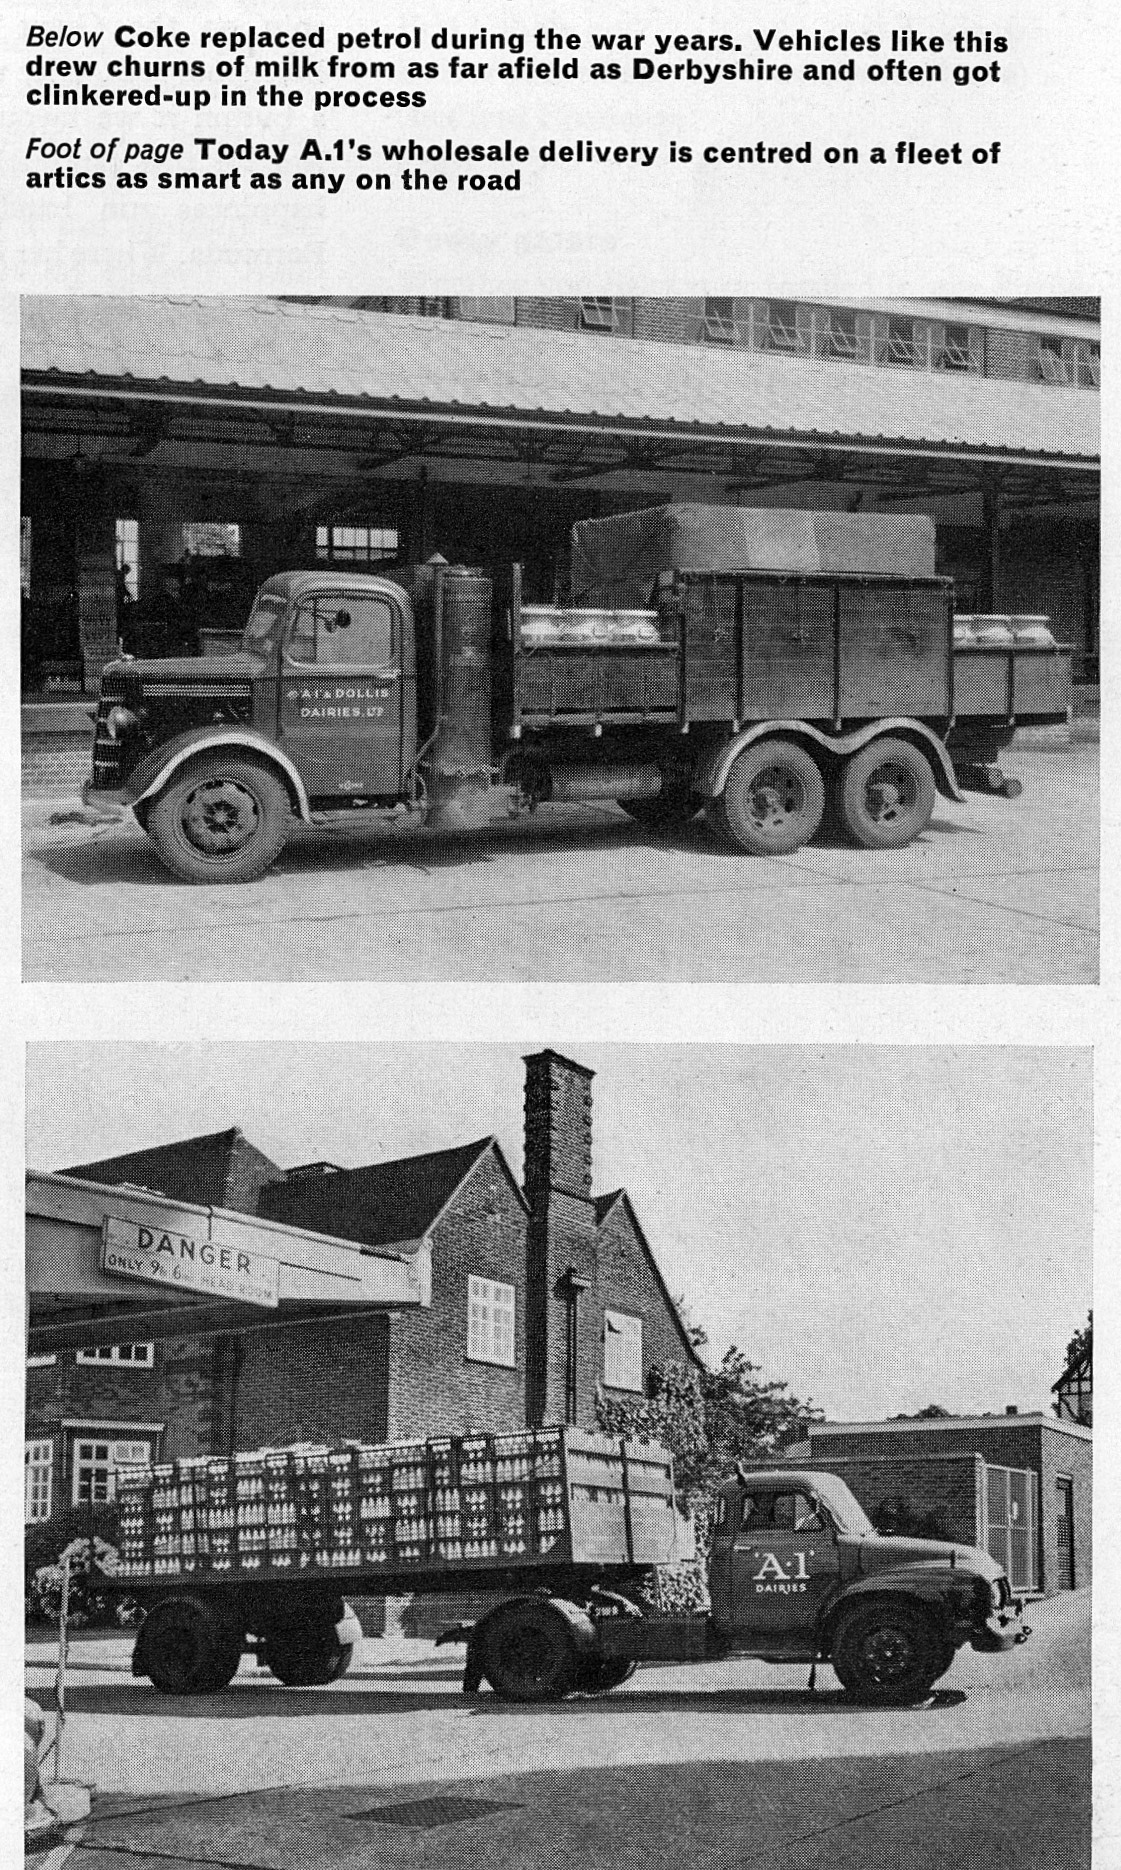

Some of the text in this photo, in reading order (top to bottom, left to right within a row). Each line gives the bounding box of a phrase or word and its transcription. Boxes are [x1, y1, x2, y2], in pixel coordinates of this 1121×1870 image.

[27, 26, 1008, 54] Below Coke replaced petrol during the war years. Vehicles like this
[26, 55, 1000, 86] drew churns of milk from as far afield as Derbyshire and often got
[27, 84, 426, 111] clinkered-up in the process
[26, 138, 1000, 166] Foot of page Today A.1's wholesale delivery is centred on a fleet of
[26, 167, 520, 193] artics as smart as any on the road
[108, 1254, 144, 1270] ONLY
[138, 1228, 250, 1274] DANGER
[756, 1583, 807, 1595] DAIRIES
